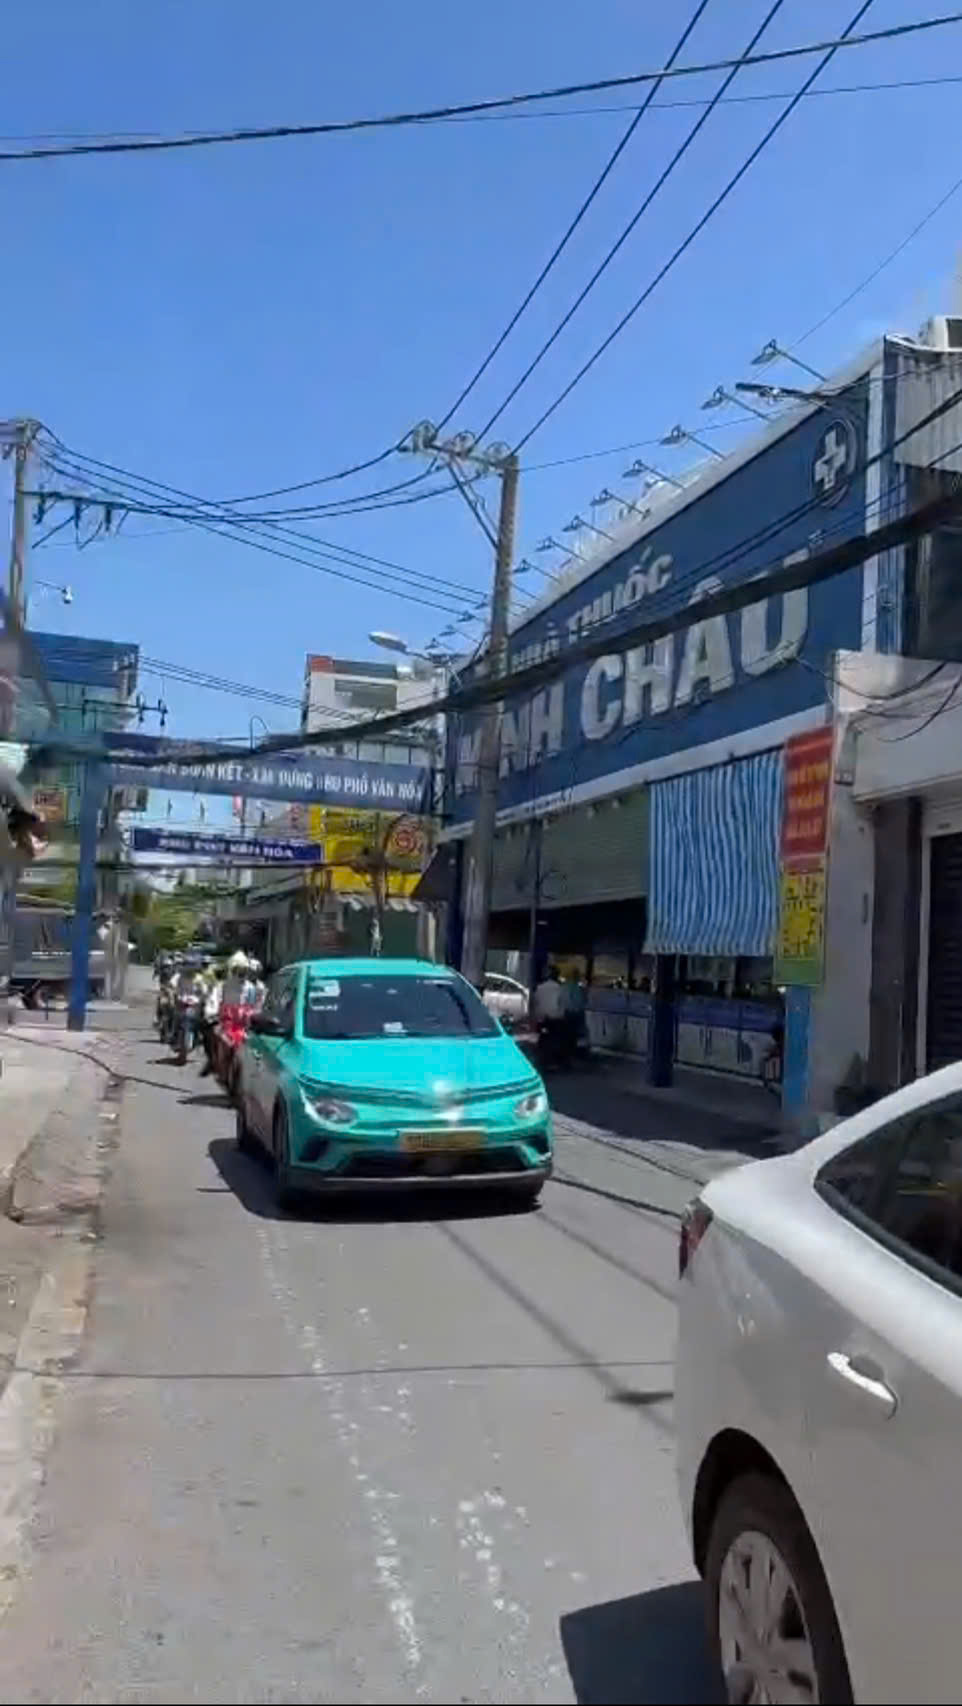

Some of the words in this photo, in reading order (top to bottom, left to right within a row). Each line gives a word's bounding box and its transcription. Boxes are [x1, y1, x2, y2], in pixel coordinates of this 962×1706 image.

[454, 682, 564, 795] MNH
[581, 547, 809, 741] CHÂU
[567, 546, 674, 645] THUỐC
